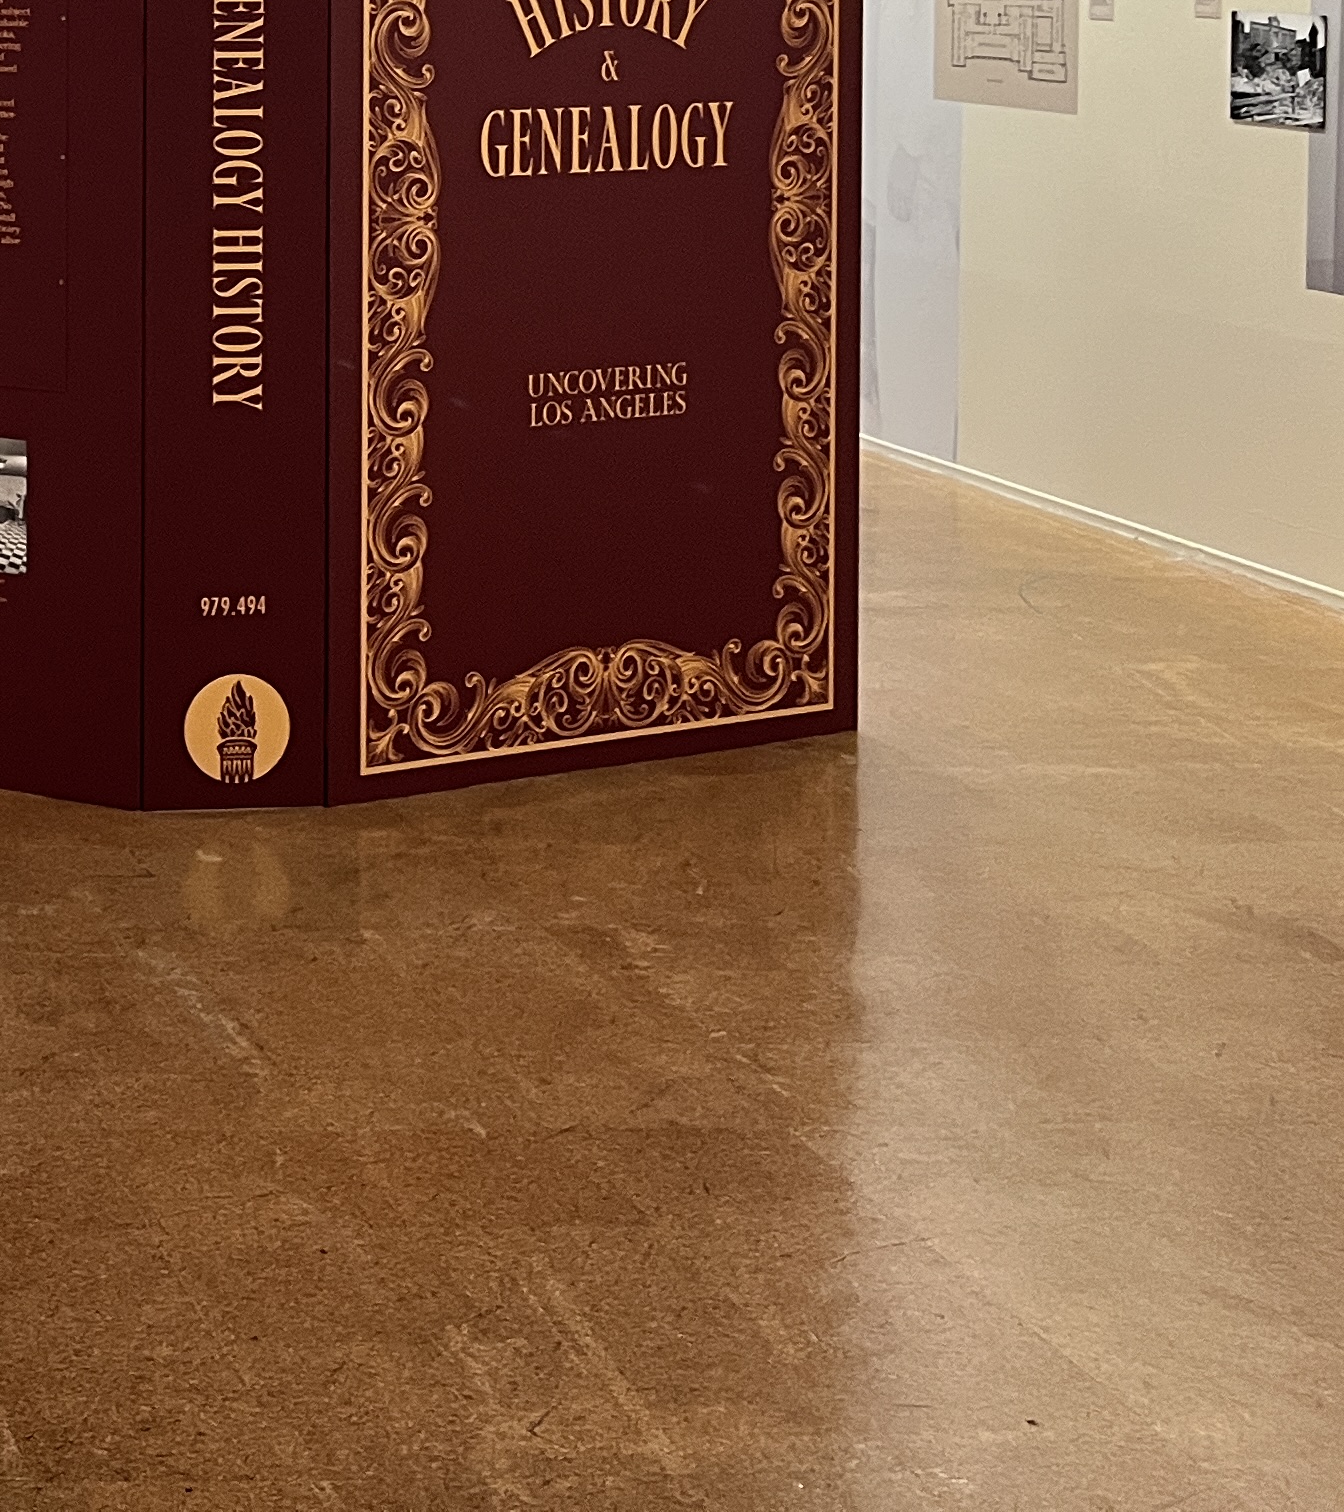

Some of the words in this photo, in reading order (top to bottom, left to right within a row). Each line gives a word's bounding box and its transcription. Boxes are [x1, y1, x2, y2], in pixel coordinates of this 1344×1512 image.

[600, 50, 619, 81] &
[480, 100, 734, 179] GENEALOGY
[211, 226, 264, 411] HISTORY
[528, 361, 688, 399] UNCOVERING
[530, 399, 573, 428] LOS
[579, 390, 688, 425] ANGELES
[200, 595, 266, 617] 979.494
